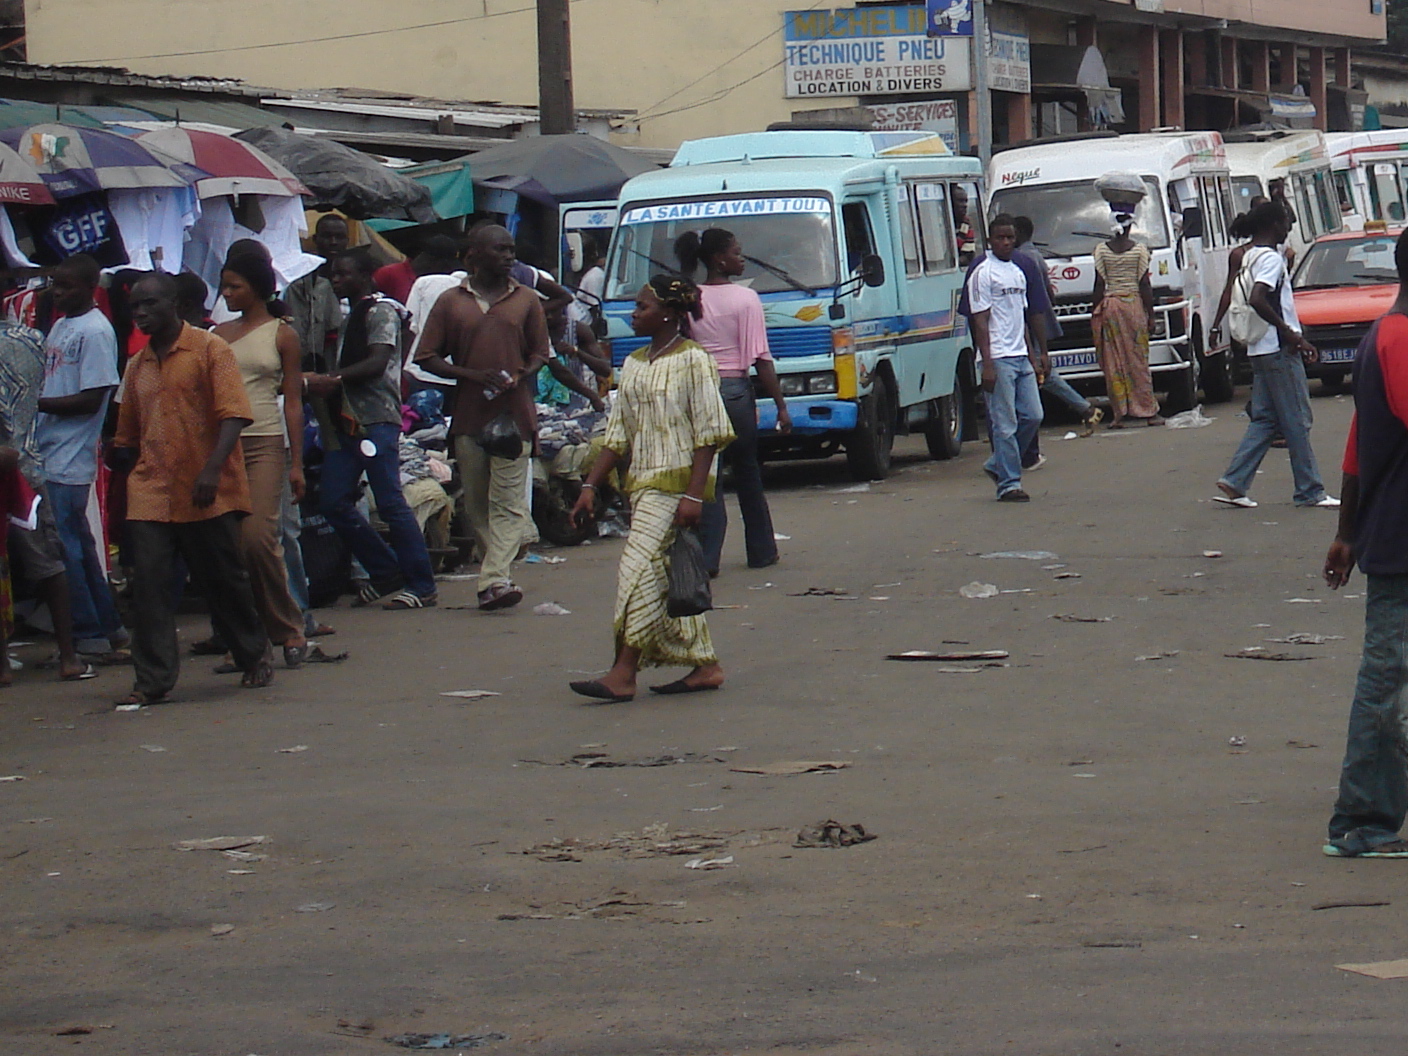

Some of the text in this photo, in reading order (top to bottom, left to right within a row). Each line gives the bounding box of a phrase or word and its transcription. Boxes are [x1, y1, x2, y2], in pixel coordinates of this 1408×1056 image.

[786, 38, 945, 66] TECHNIQUE PNEU
[793, 64, 946, 82] CHARGE BATTERIES
[798, 77, 942, 95] LOCATION & DIVERS
[867, 102, 956, 124] S-SERVICES
[627, 197, 827, 222] LA SANTE AVANT TOUT
